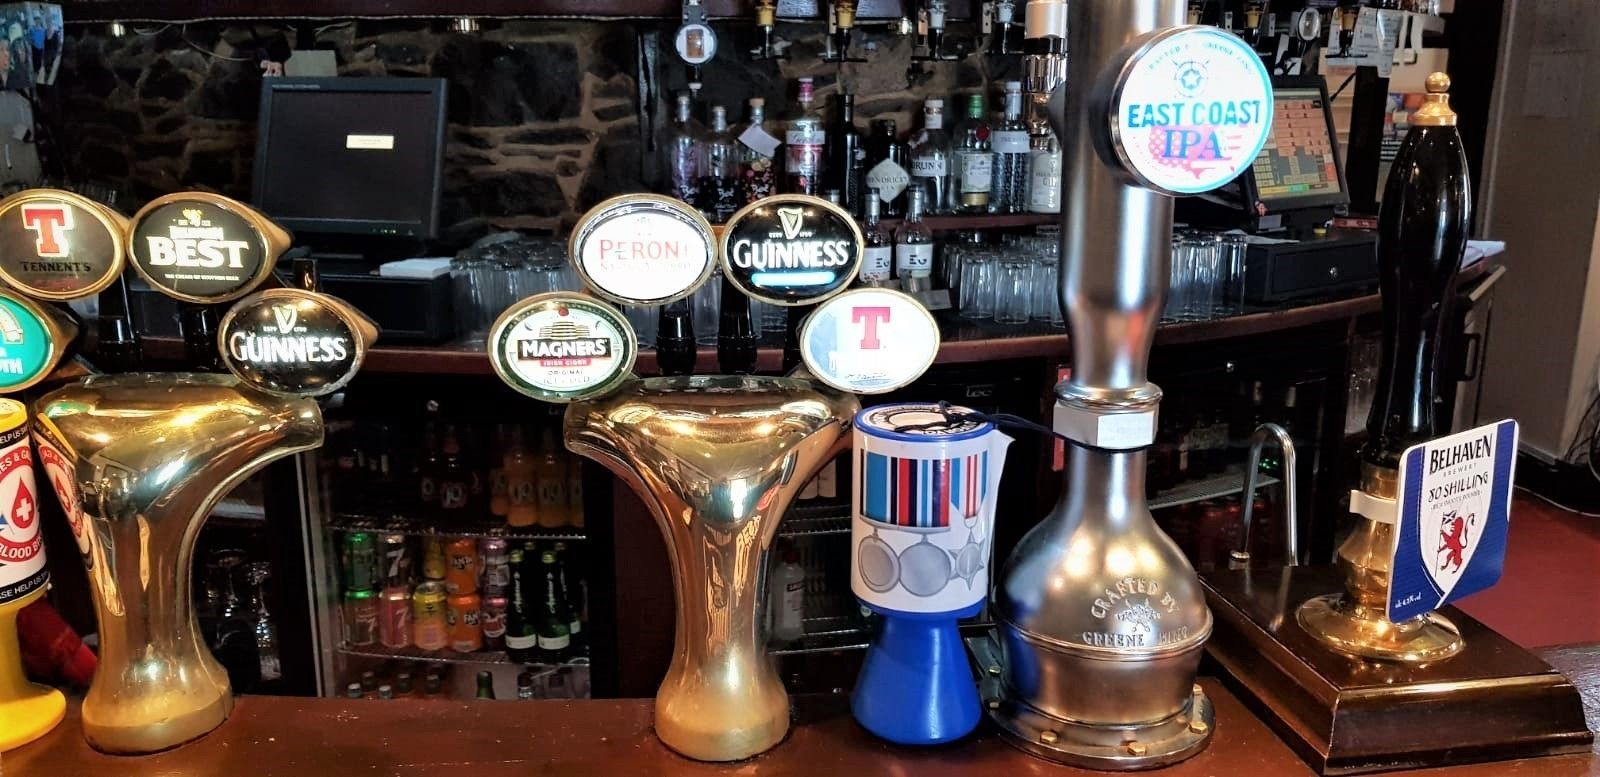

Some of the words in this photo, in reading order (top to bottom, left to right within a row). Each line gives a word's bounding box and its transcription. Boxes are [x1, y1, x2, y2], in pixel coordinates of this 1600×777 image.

[1128, 103, 1184, 127] EAST
[1192, 100, 1260, 125] COAST
[1162, 129, 1223, 159] IPA
[22, 205, 70, 256] T
[146, 236, 249, 268] BEST
[600, 239, 688, 260] PERONI
[733, 240, 849, 268] GUINNESS
[21, 260, 91, 272] TENNENT'S
[852, 306, 891, 349] T
[230, 331, 347, 362] GUINNESS
[522, 339, 607, 358] MAGNERS
[1429, 433, 1493, 475] BELHAVEN
[1443, 470, 1489, 498] SHILLING
[14, 580, 33, 594] HELP
[1090, 576, 1161, 619] CRAFTED
[1082, 631, 1145, 647] GREENE
